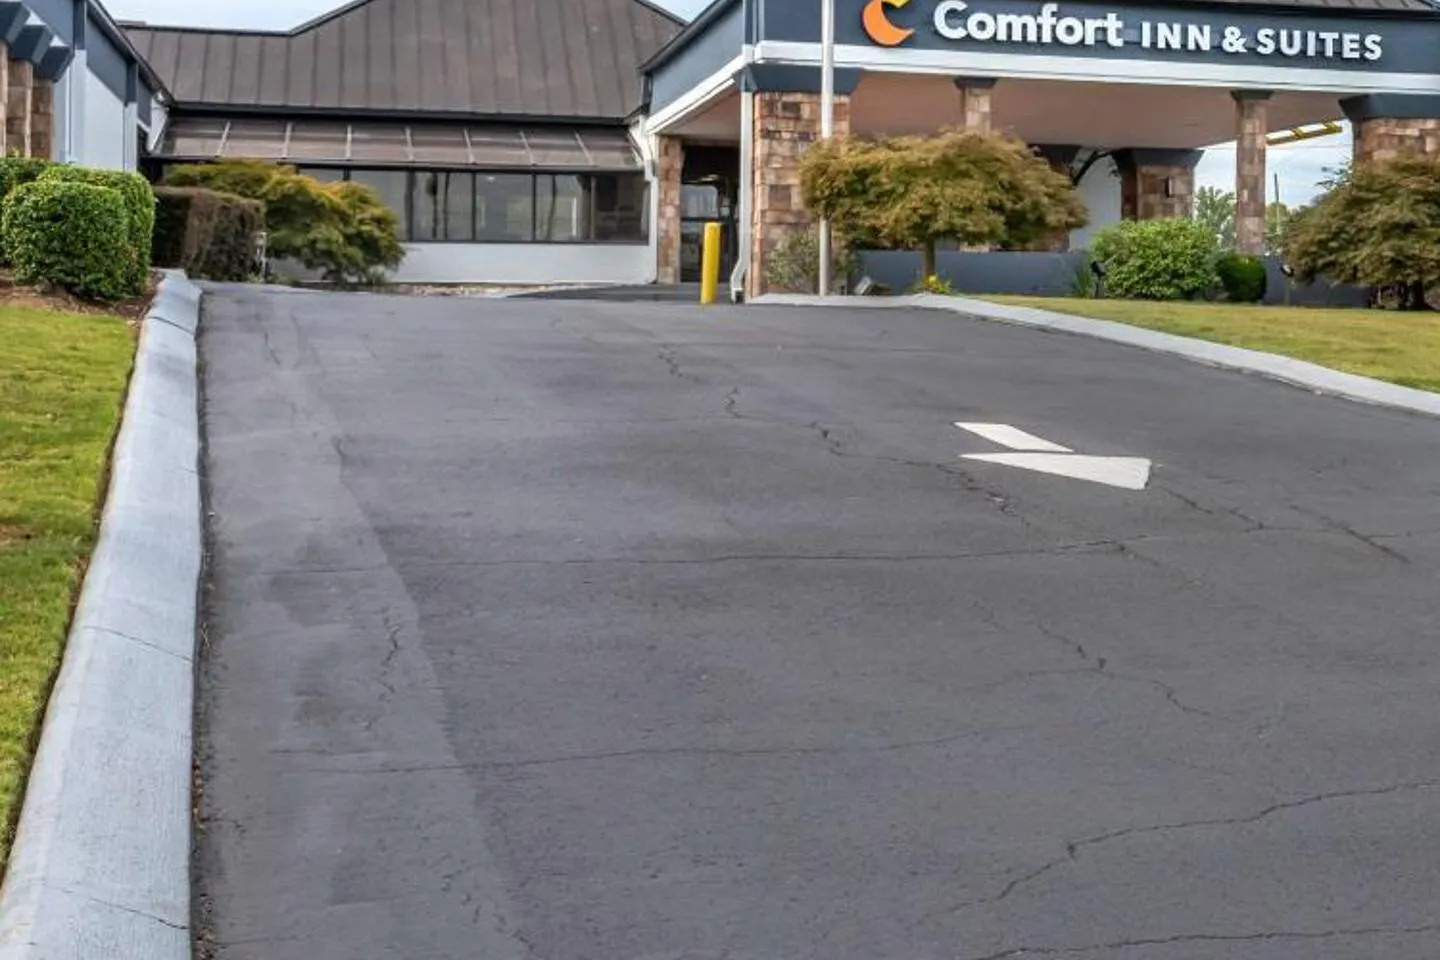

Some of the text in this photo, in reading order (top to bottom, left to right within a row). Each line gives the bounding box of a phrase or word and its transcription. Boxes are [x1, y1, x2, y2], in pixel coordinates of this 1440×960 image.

[932, 0, 1383, 60] Comfort INN & SUITES
